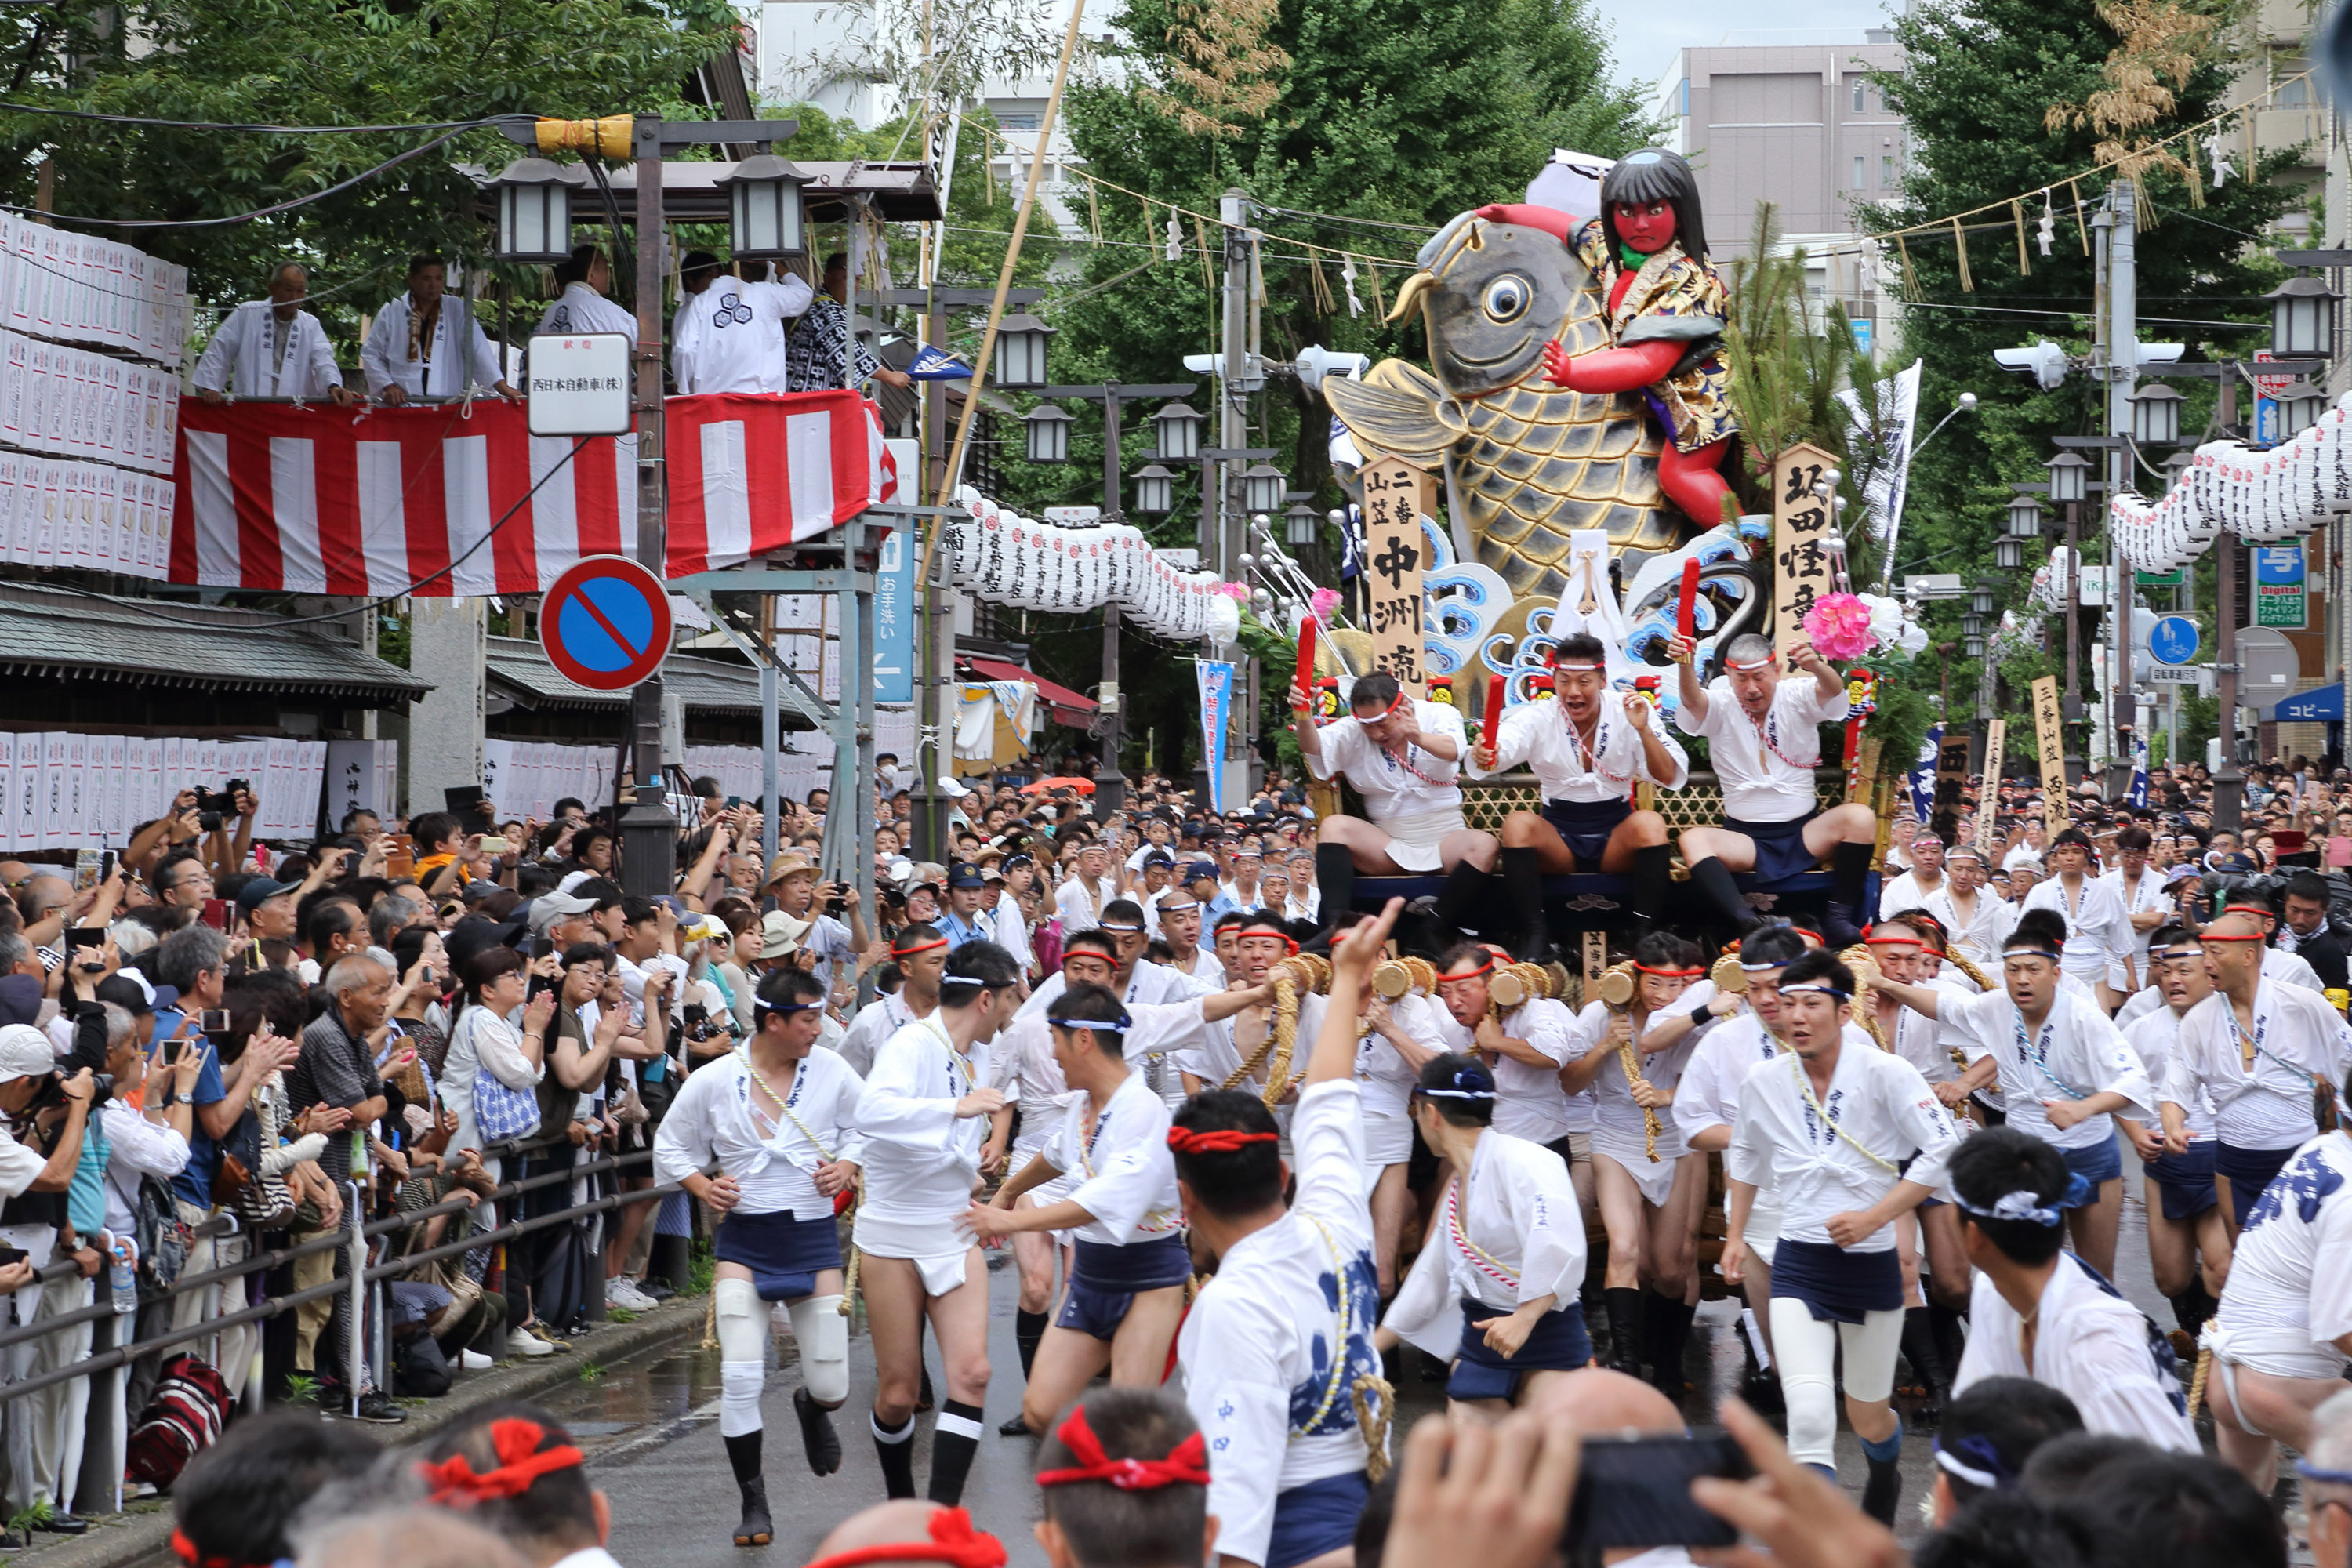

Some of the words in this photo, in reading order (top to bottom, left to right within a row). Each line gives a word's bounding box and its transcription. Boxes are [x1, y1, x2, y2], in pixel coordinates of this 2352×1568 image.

[532, 377, 624, 392] 西日本自動車(株)
[1366, 471, 1390, 525] 山笠
[1392, 470, 1414, 524] 二番
[1780, 463, 1828, 673] 坂田怪童
[2260, 585, 2301, 596] Digital
[880, 578, 897, 641] お手洗い
[1374, 535, 1423, 684] 中洲流
[2259, 597, 2302, 605] データ入出力
[2153, 670, 2198, 681] 自転車通行可
[2039, 685, 2060, 764] 三番山笠
[2288, 703, 2332, 718] コピー
[2046, 774, 2068, 824] 西流
